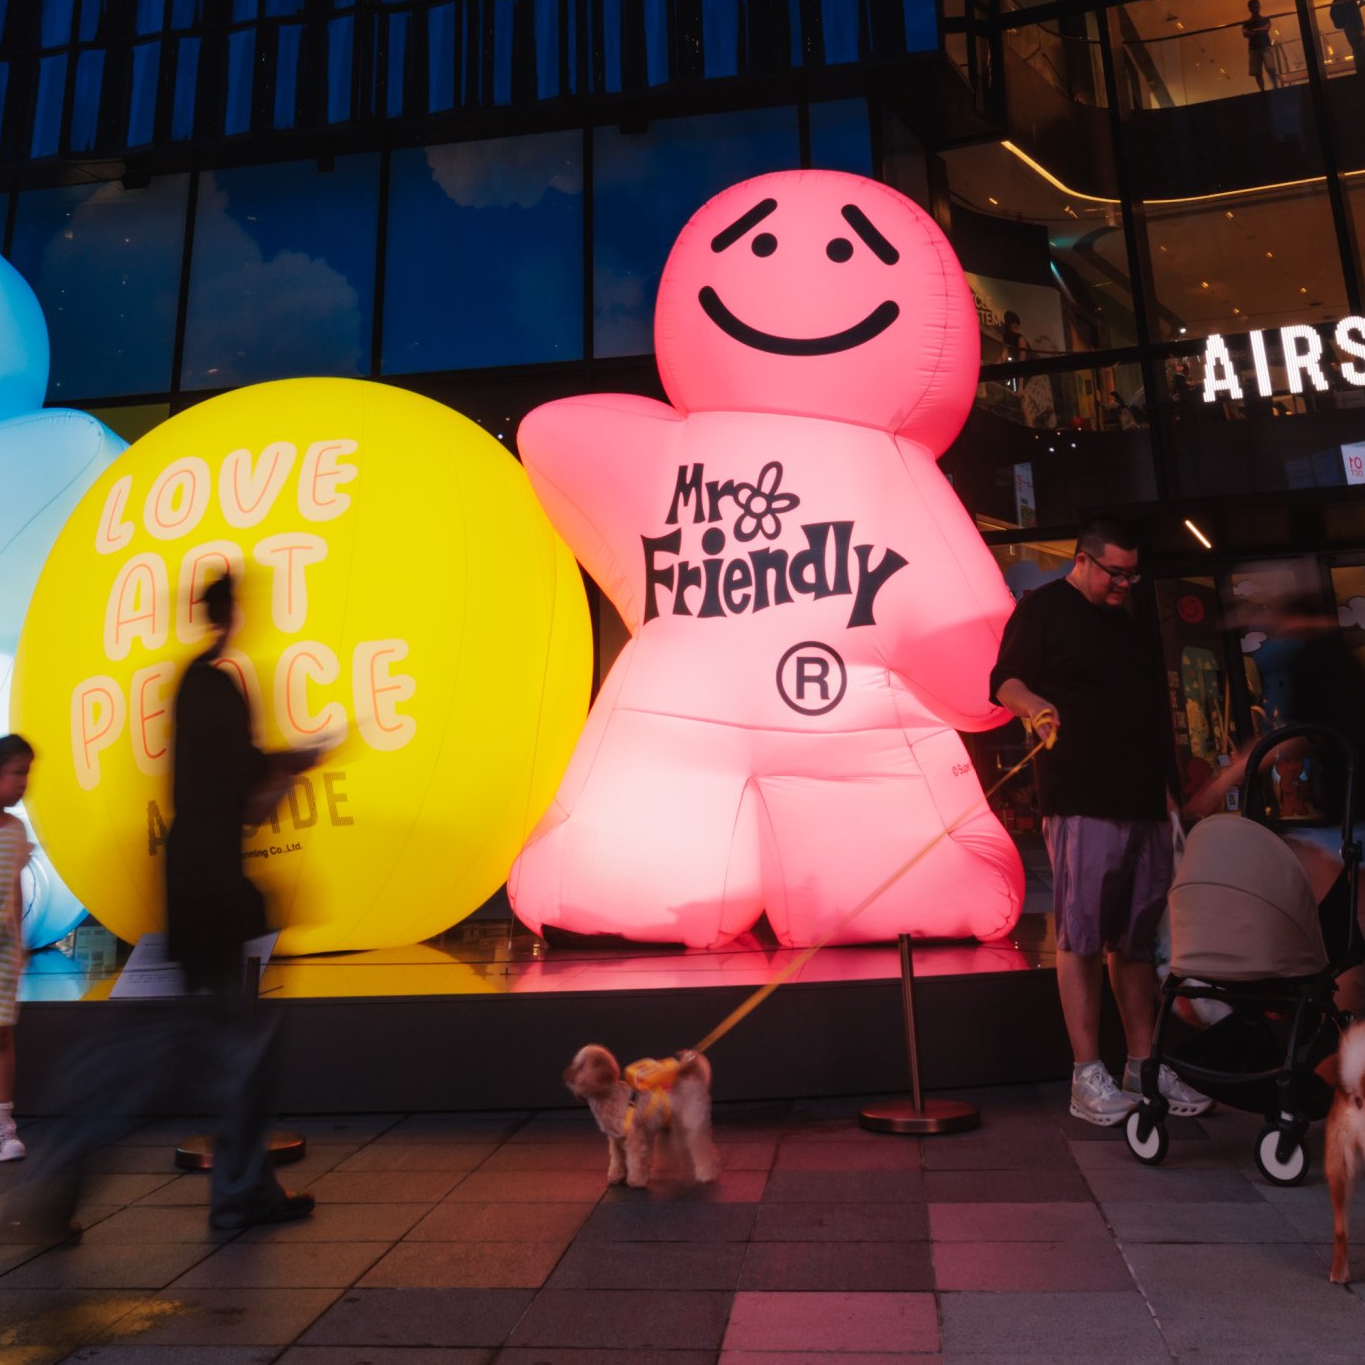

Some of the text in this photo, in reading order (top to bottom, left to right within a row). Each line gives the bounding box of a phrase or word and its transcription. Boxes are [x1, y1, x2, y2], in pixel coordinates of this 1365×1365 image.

[95, 439, 358, 555] LOVE
[103, 532, 328, 661] ART
[641, 521, 909, 629] Friendly
